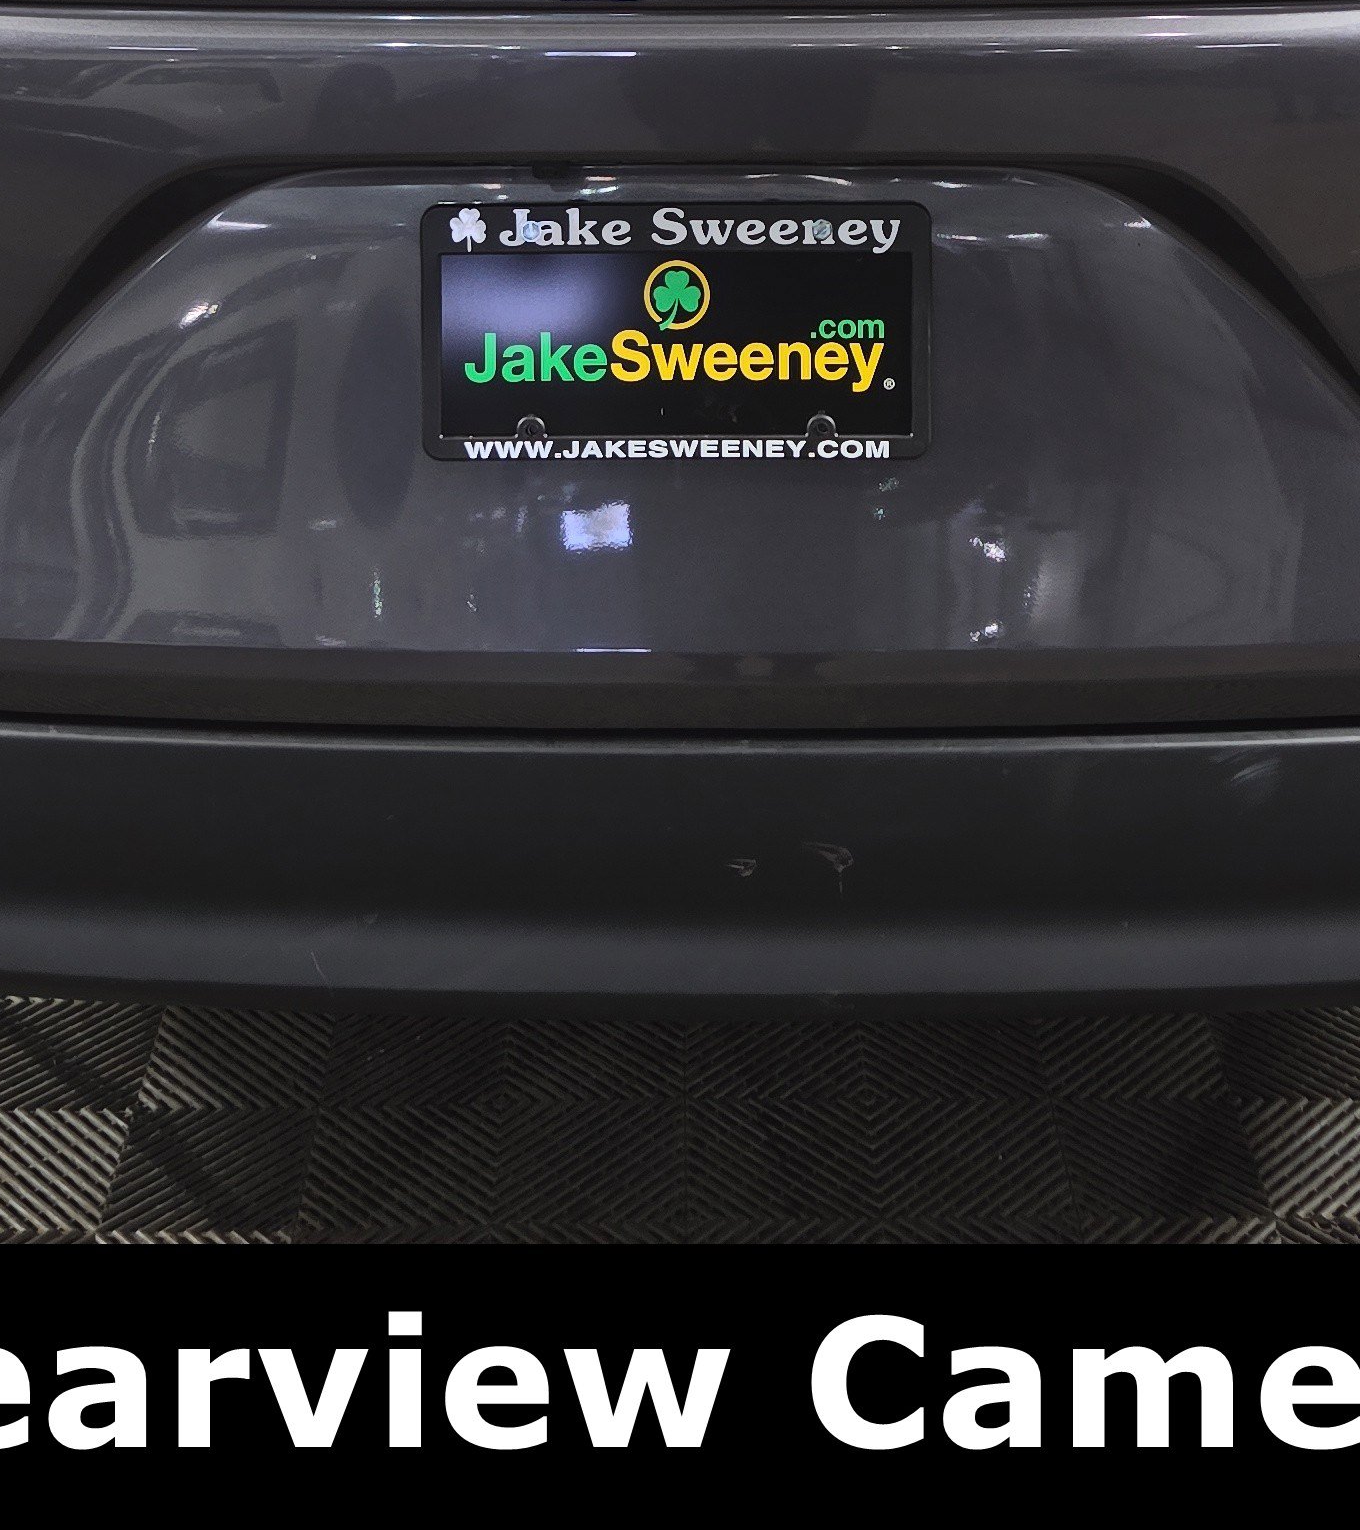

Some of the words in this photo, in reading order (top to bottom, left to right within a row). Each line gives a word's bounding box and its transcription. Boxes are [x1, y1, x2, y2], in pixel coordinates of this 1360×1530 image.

[499, 207, 633, 247] Jake
[651, 207, 901, 254] Sweeney
[464, 329, 886, 392] JakeSweeney
[464, 439, 890, 459] WWW.JAKESWEENEY.COM
